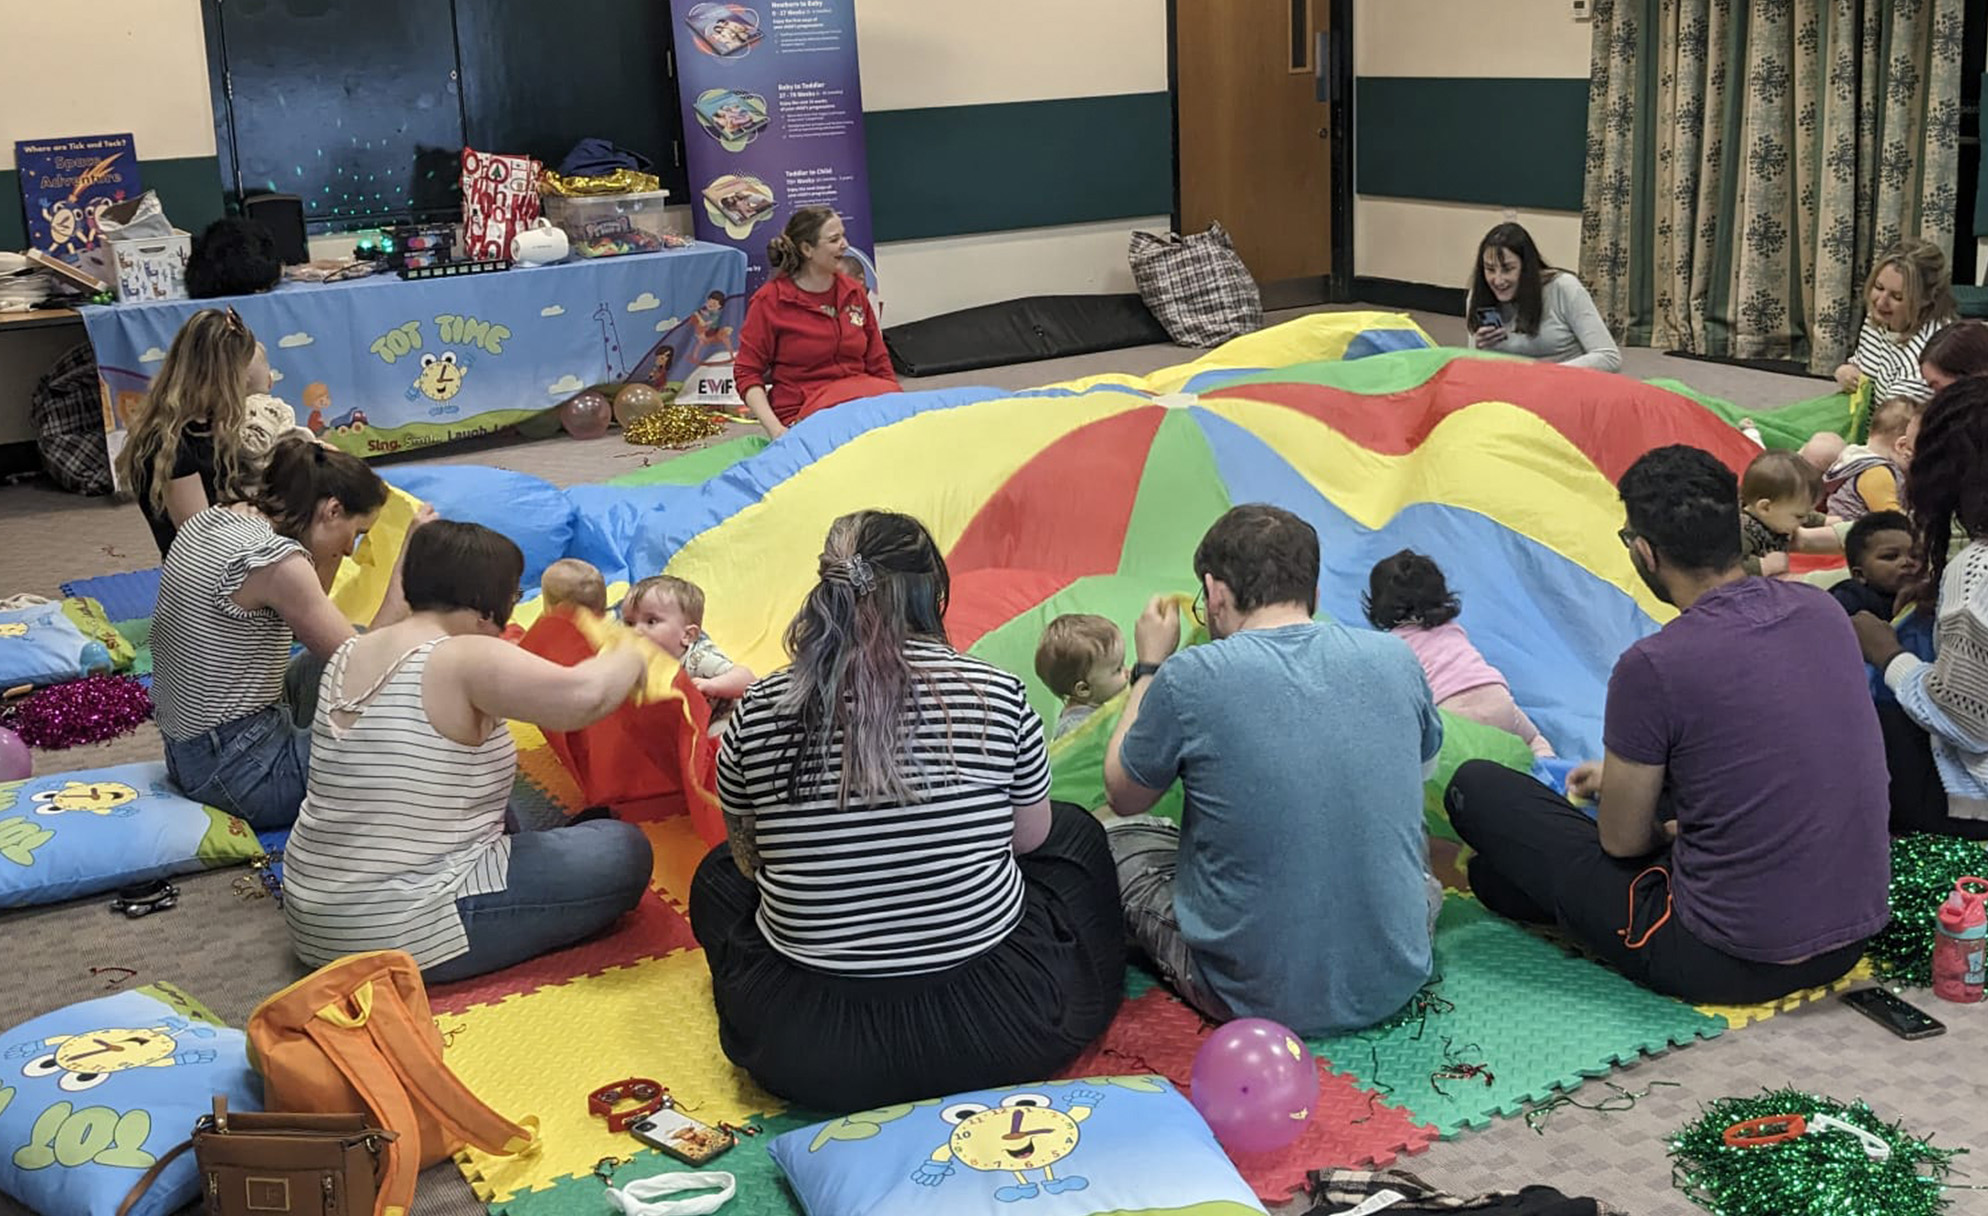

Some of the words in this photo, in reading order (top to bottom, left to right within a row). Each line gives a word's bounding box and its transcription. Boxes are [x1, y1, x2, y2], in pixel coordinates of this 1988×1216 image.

[808, 0, 823, 8] Baby
[778, 83, 793, 91] Baby
[802, 81, 825, 89] Toddler
[23, 145, 51, 153] Where
[69, 141, 85, 150] Tick
[103, 139, 126, 147] Tock?
[54, 156, 99, 171] Space
[40, 173, 122, 189] Adventure
[370, 320, 422, 363] TOT
[434, 314, 511, 355] TIME
[368, 438, 401, 452] Sing.
[992, 1108, 1007, 1116] 12
[969, 1116, 984, 1125] 11
[955, 1130, 971, 1140] 10
[1051, 1150, 1060, 1158] 5
[993, 1160, 1001, 1168] 7
[1024, 1160, 1034, 1168] 6
